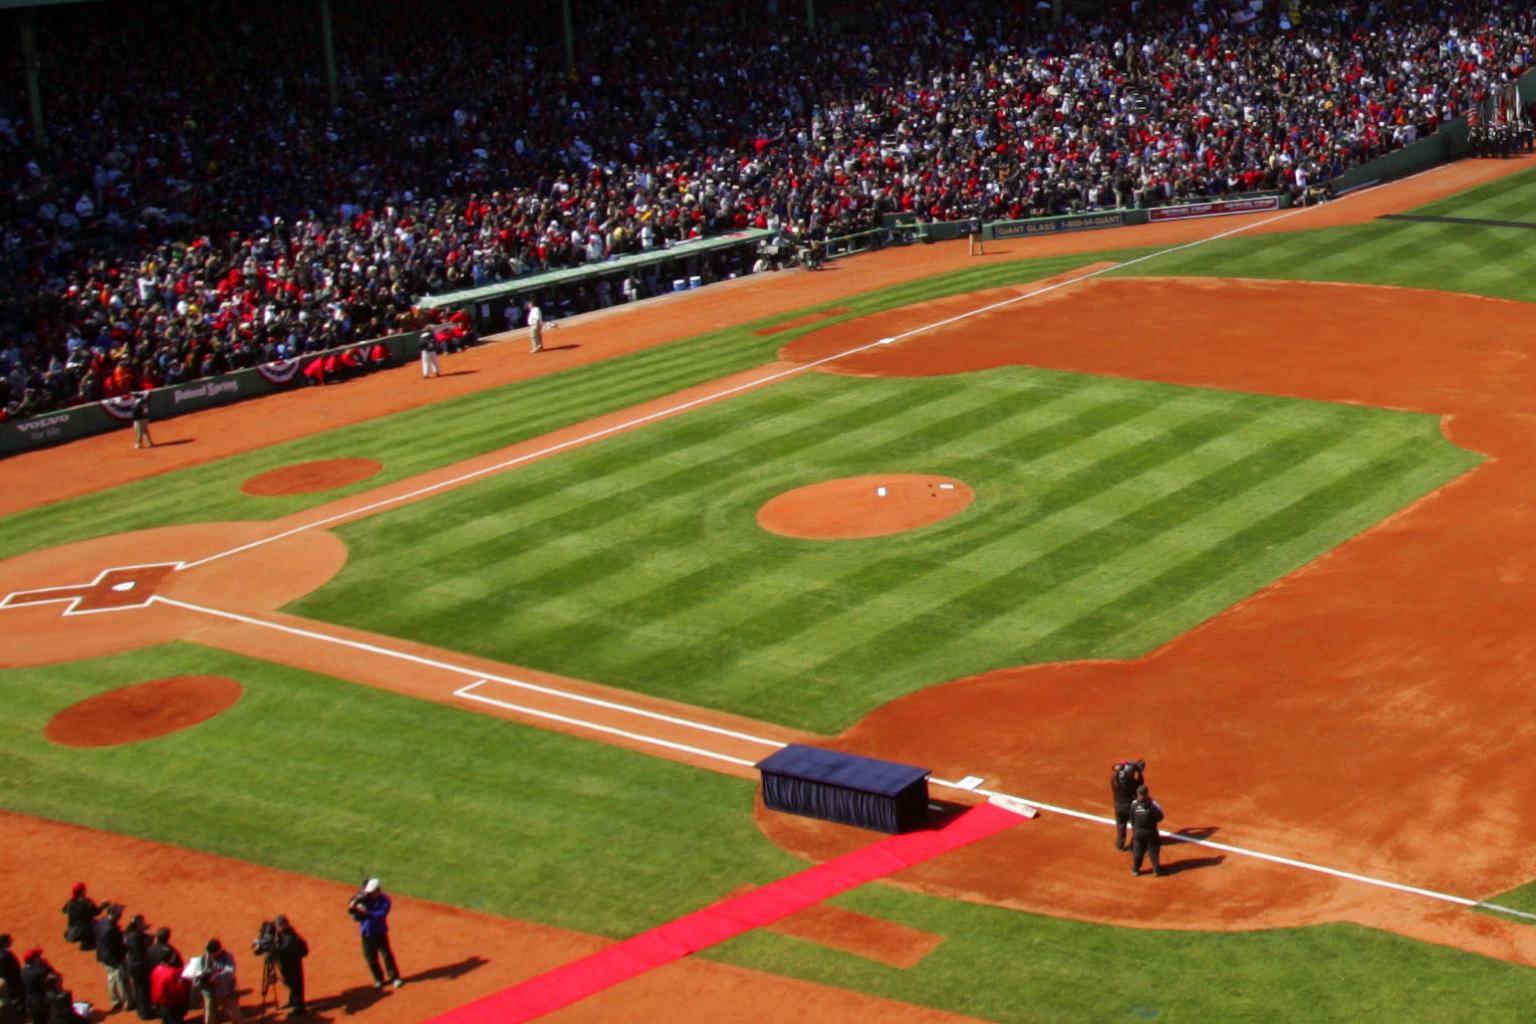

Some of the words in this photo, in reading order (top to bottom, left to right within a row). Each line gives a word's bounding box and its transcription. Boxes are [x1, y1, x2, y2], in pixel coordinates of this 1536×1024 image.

[998, 225, 1025, 234] GIANT
[1027, 222, 1057, 232] GLASS
[17, 414, 69, 432] VOLVO
